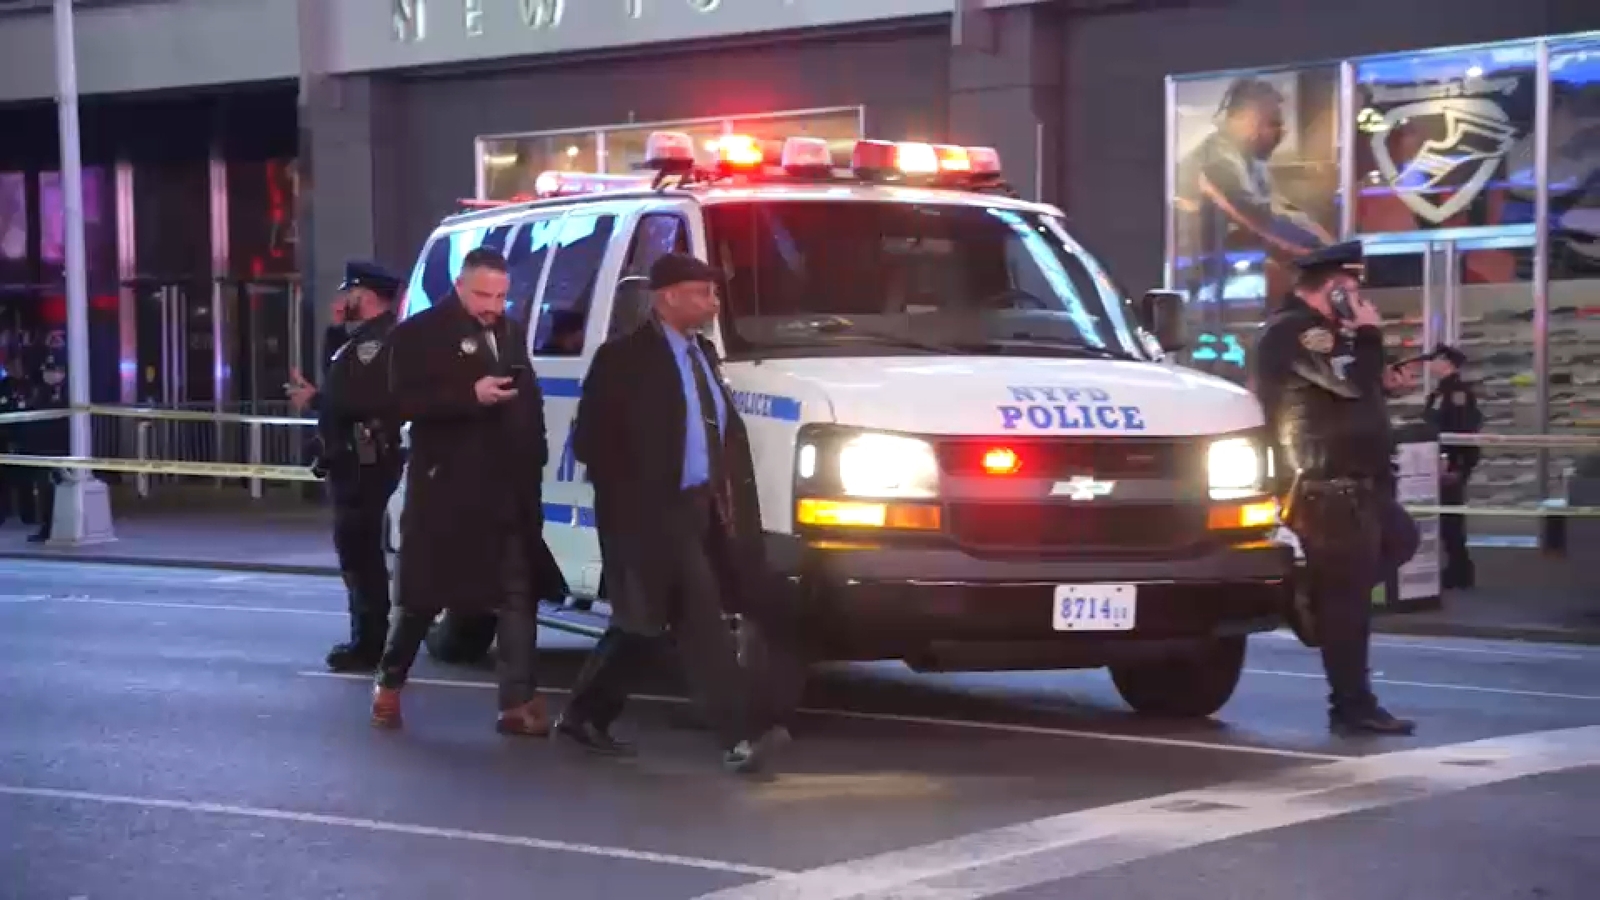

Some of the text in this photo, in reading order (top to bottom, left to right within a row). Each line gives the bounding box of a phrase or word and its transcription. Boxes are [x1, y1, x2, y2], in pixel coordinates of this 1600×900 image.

[391, 0, 565, 42] NEW
[1006, 385, 1111, 402] NYPD
[996, 405, 1144, 430] POLICE
[1060, 597, 1111, 620] 8714
